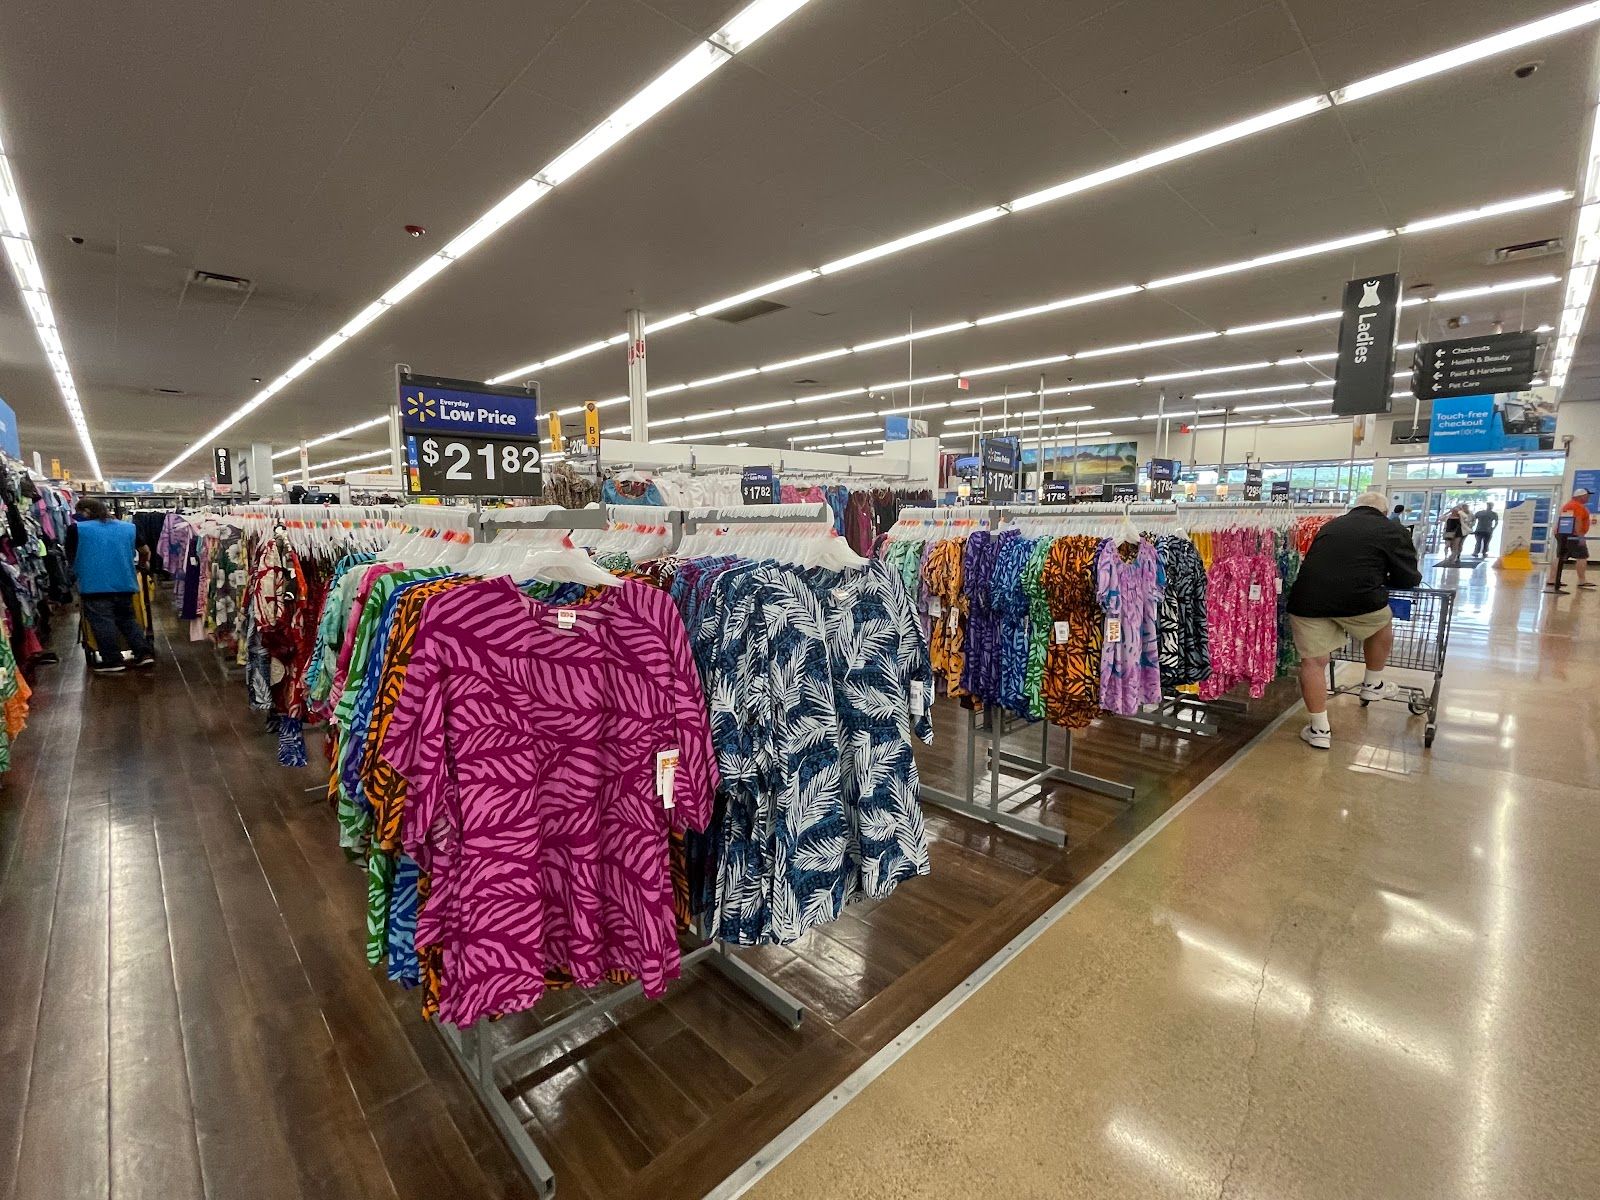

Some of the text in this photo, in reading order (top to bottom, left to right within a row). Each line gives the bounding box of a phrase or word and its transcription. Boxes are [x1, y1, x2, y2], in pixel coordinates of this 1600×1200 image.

[1354, 312, 1377, 364] Ladies
[1452, 345, 1490, 354] Checkouts
[1451, 358, 1475, 366] Health
[1484, 354, 1511, 363] Beauty
[1477, 366, 1513, 375] Hardware
[440, 399, 469, 408] Everyday
[440, 405, 517, 425] Low Price
[1437, 410, 1489, 421] Touch-free
[1438, 419, 1484, 428] checkout
[589, 426, 596, 435] B
[590, 437, 596, 445] 3
[988, 471, 1013, 492] $1782
[744, 486, 770, 499] $1782
